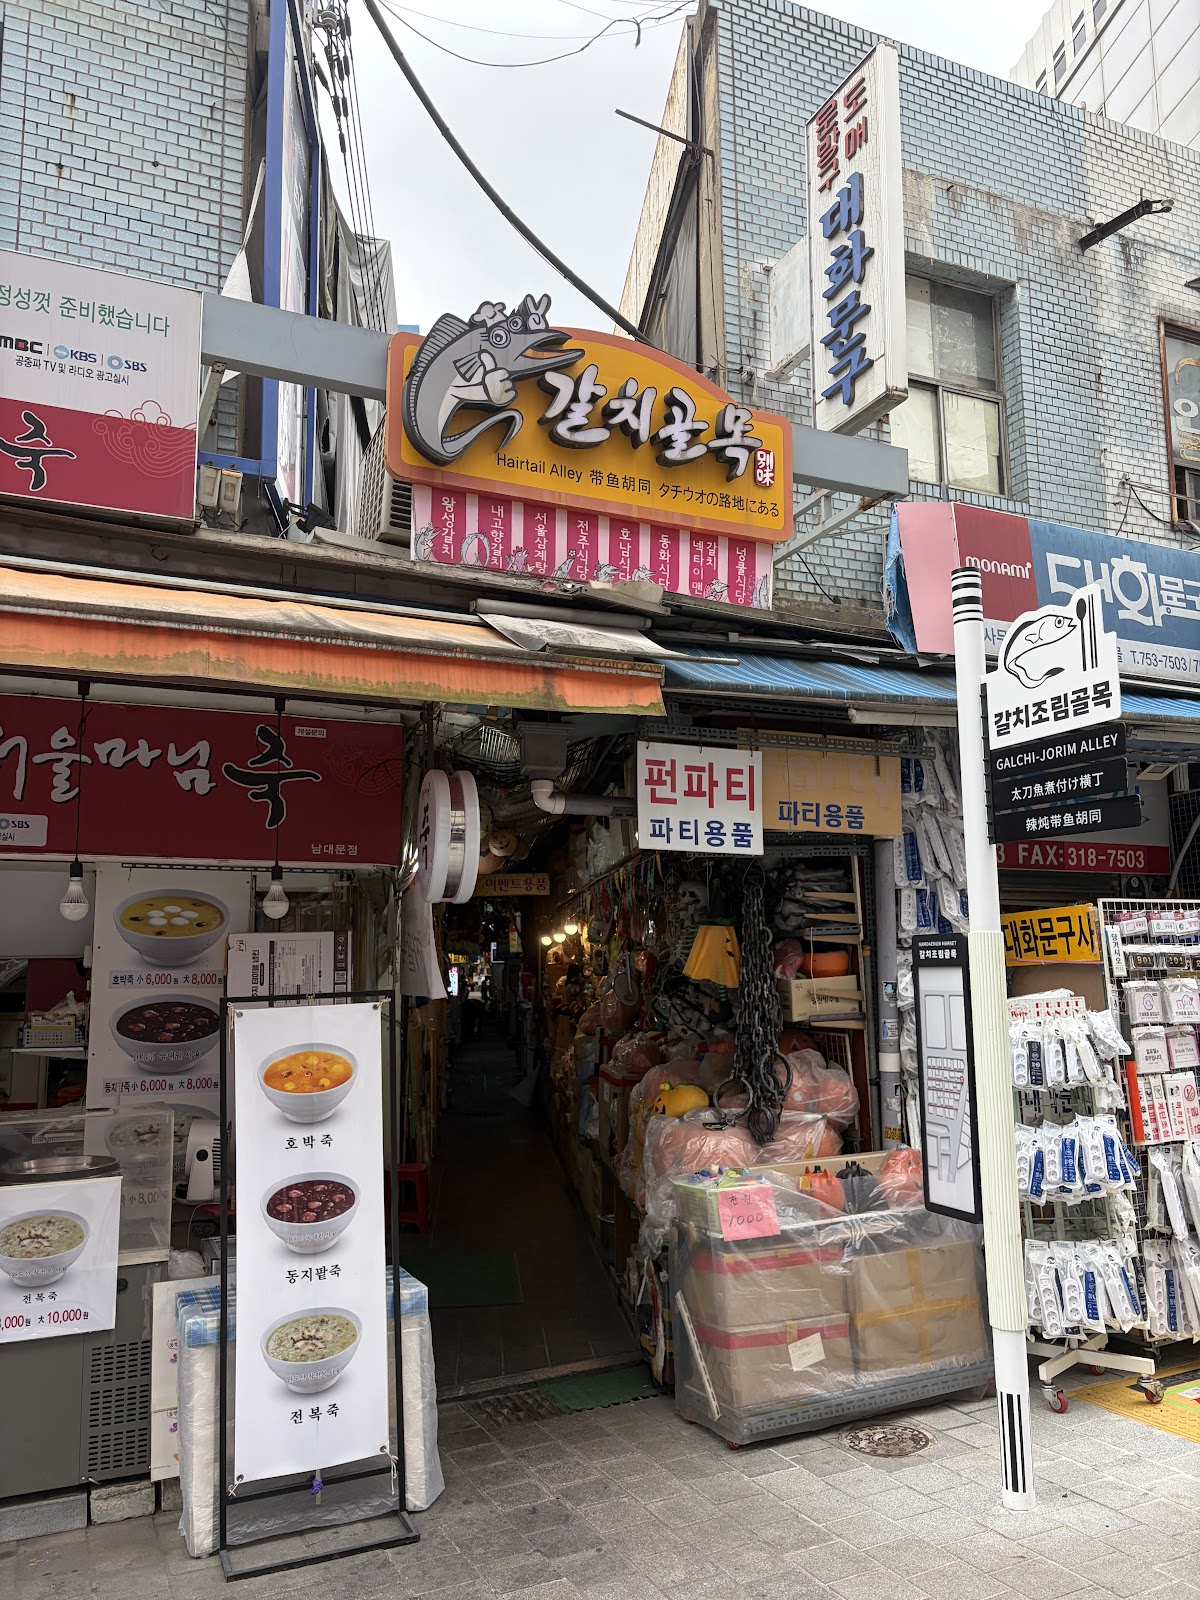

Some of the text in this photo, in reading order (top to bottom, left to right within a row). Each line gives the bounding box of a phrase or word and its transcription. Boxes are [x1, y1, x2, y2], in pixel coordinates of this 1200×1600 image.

[843, 76, 868, 161] 도매
[819, 171, 875, 407] 대화문구
[0, 284, 171, 338] 정성껏 준비했습니다
[15, 355, 130, 386] 공중파 TV 및 라디오 광고실시
[70, 349, 97, 363] KBS
[124, 359, 148, 373] SBS
[537, 363, 763, 483] 갈치골목
[496, 452, 583, 484] Hairtail Alley
[589, 468, 652, 495] 带鱼胡同
[658, 481, 780, 519] タチウオの路地にある
[441, 496, 457, 560] 왕성갈치
[490, 504, 504, 570] 내고향갈치
[534, 512, 548, 576] 서울삼계탕
[576, 519, 590, 581] 전주식당
[658, 534, 671, 591] 동화식당
[706, 541, 718, 571] 갈치
[692, 540, 704, 596] 넥타이맨
[993, 680, 1113, 738] 갈치조림골목
[297, 727, 325, 737] 개설문의
[996, 732, 1119, 772] GALCHI-JORIM ALLEY
[222, 724, 323, 829] 죽
[644, 758, 755, 812] 펀파티
[1011, 772, 1104, 802] 太刀魚煮付け横丁
[11, 820, 30, 829] SBS
[778, 800, 865, 830] 파티용품
[1025, 808, 1102, 832] 辣炖带鱼胡同
[311, 843, 358, 856] 남대문점
[649, 817, 754, 849] 파티용품
[485, 877, 547, 892] 이벤트용품
[1001, 912, 1095, 959] 대화문구사
[919, 949, 957, 960] 갈치조림골목
[112, 975, 134, 986] 호박죽
[136, 975, 144, 985] 小
[183, 975, 191, 985] 大
[178, 1079, 185, 1089] 大
[1158, 1101, 1170, 1138] 계단조심
[1175, 1101, 1185, 1136] 머리조심
[284, 1264, 342, 1284] 동지팥죽
[38, 1315, 45, 1324] 大
